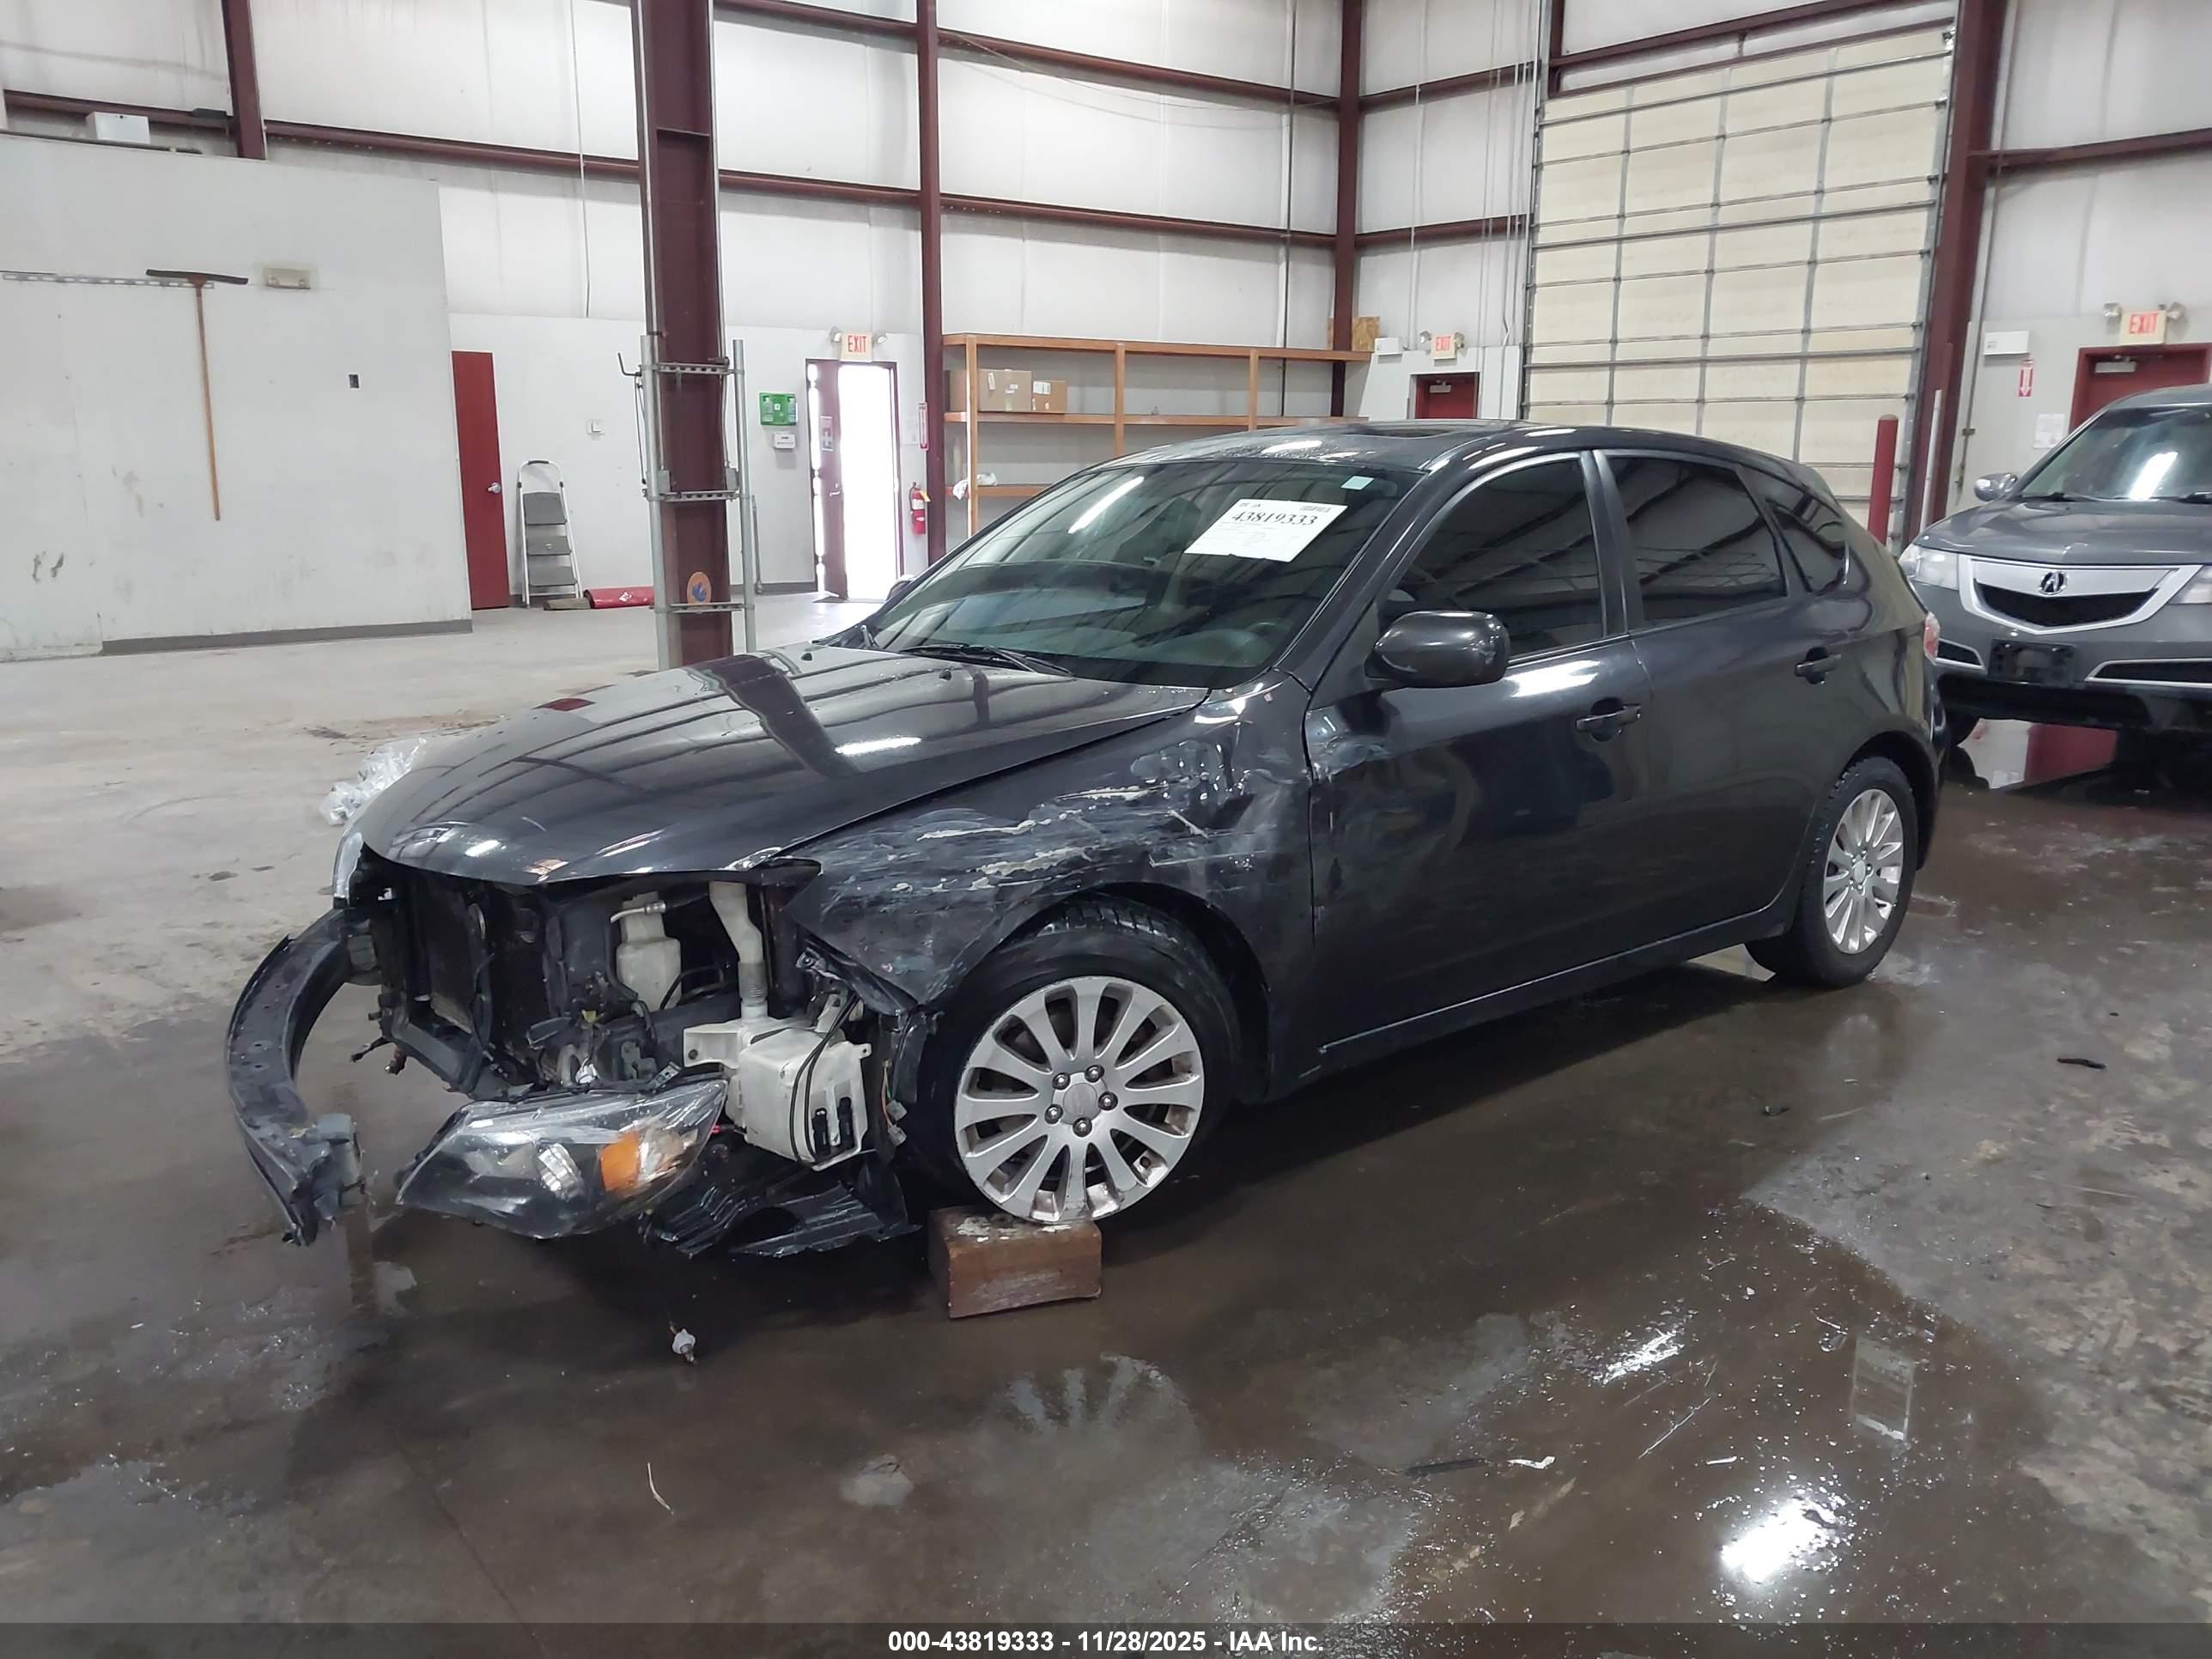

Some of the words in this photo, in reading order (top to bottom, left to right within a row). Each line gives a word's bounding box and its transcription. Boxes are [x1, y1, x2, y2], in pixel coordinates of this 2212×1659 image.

[2129, 312, 2159, 334] EXIT
[848, 335, 867, 353] EXIT
[1231, 510, 1318, 526] 43819333
